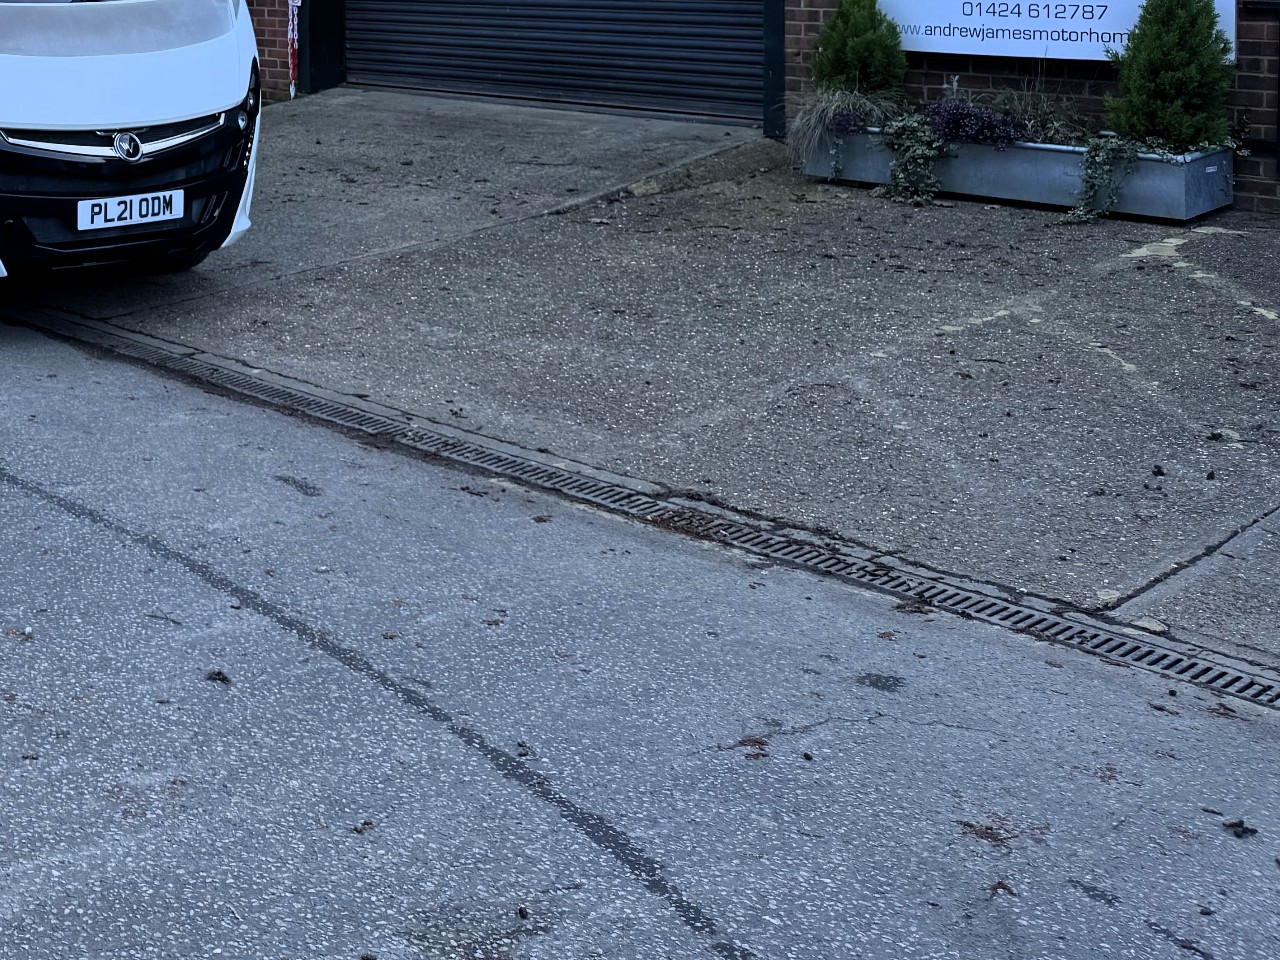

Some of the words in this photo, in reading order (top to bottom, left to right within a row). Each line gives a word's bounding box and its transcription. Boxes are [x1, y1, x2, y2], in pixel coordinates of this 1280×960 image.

[962, 1, 1022, 18] 01424
[1028, 3, 1108, 20] 612787
[896, 22, 1130, 44] ww.andrewjamesmotorhom
[90, 199, 133, 224] PL21
[139, 194, 173, 219] ODM
